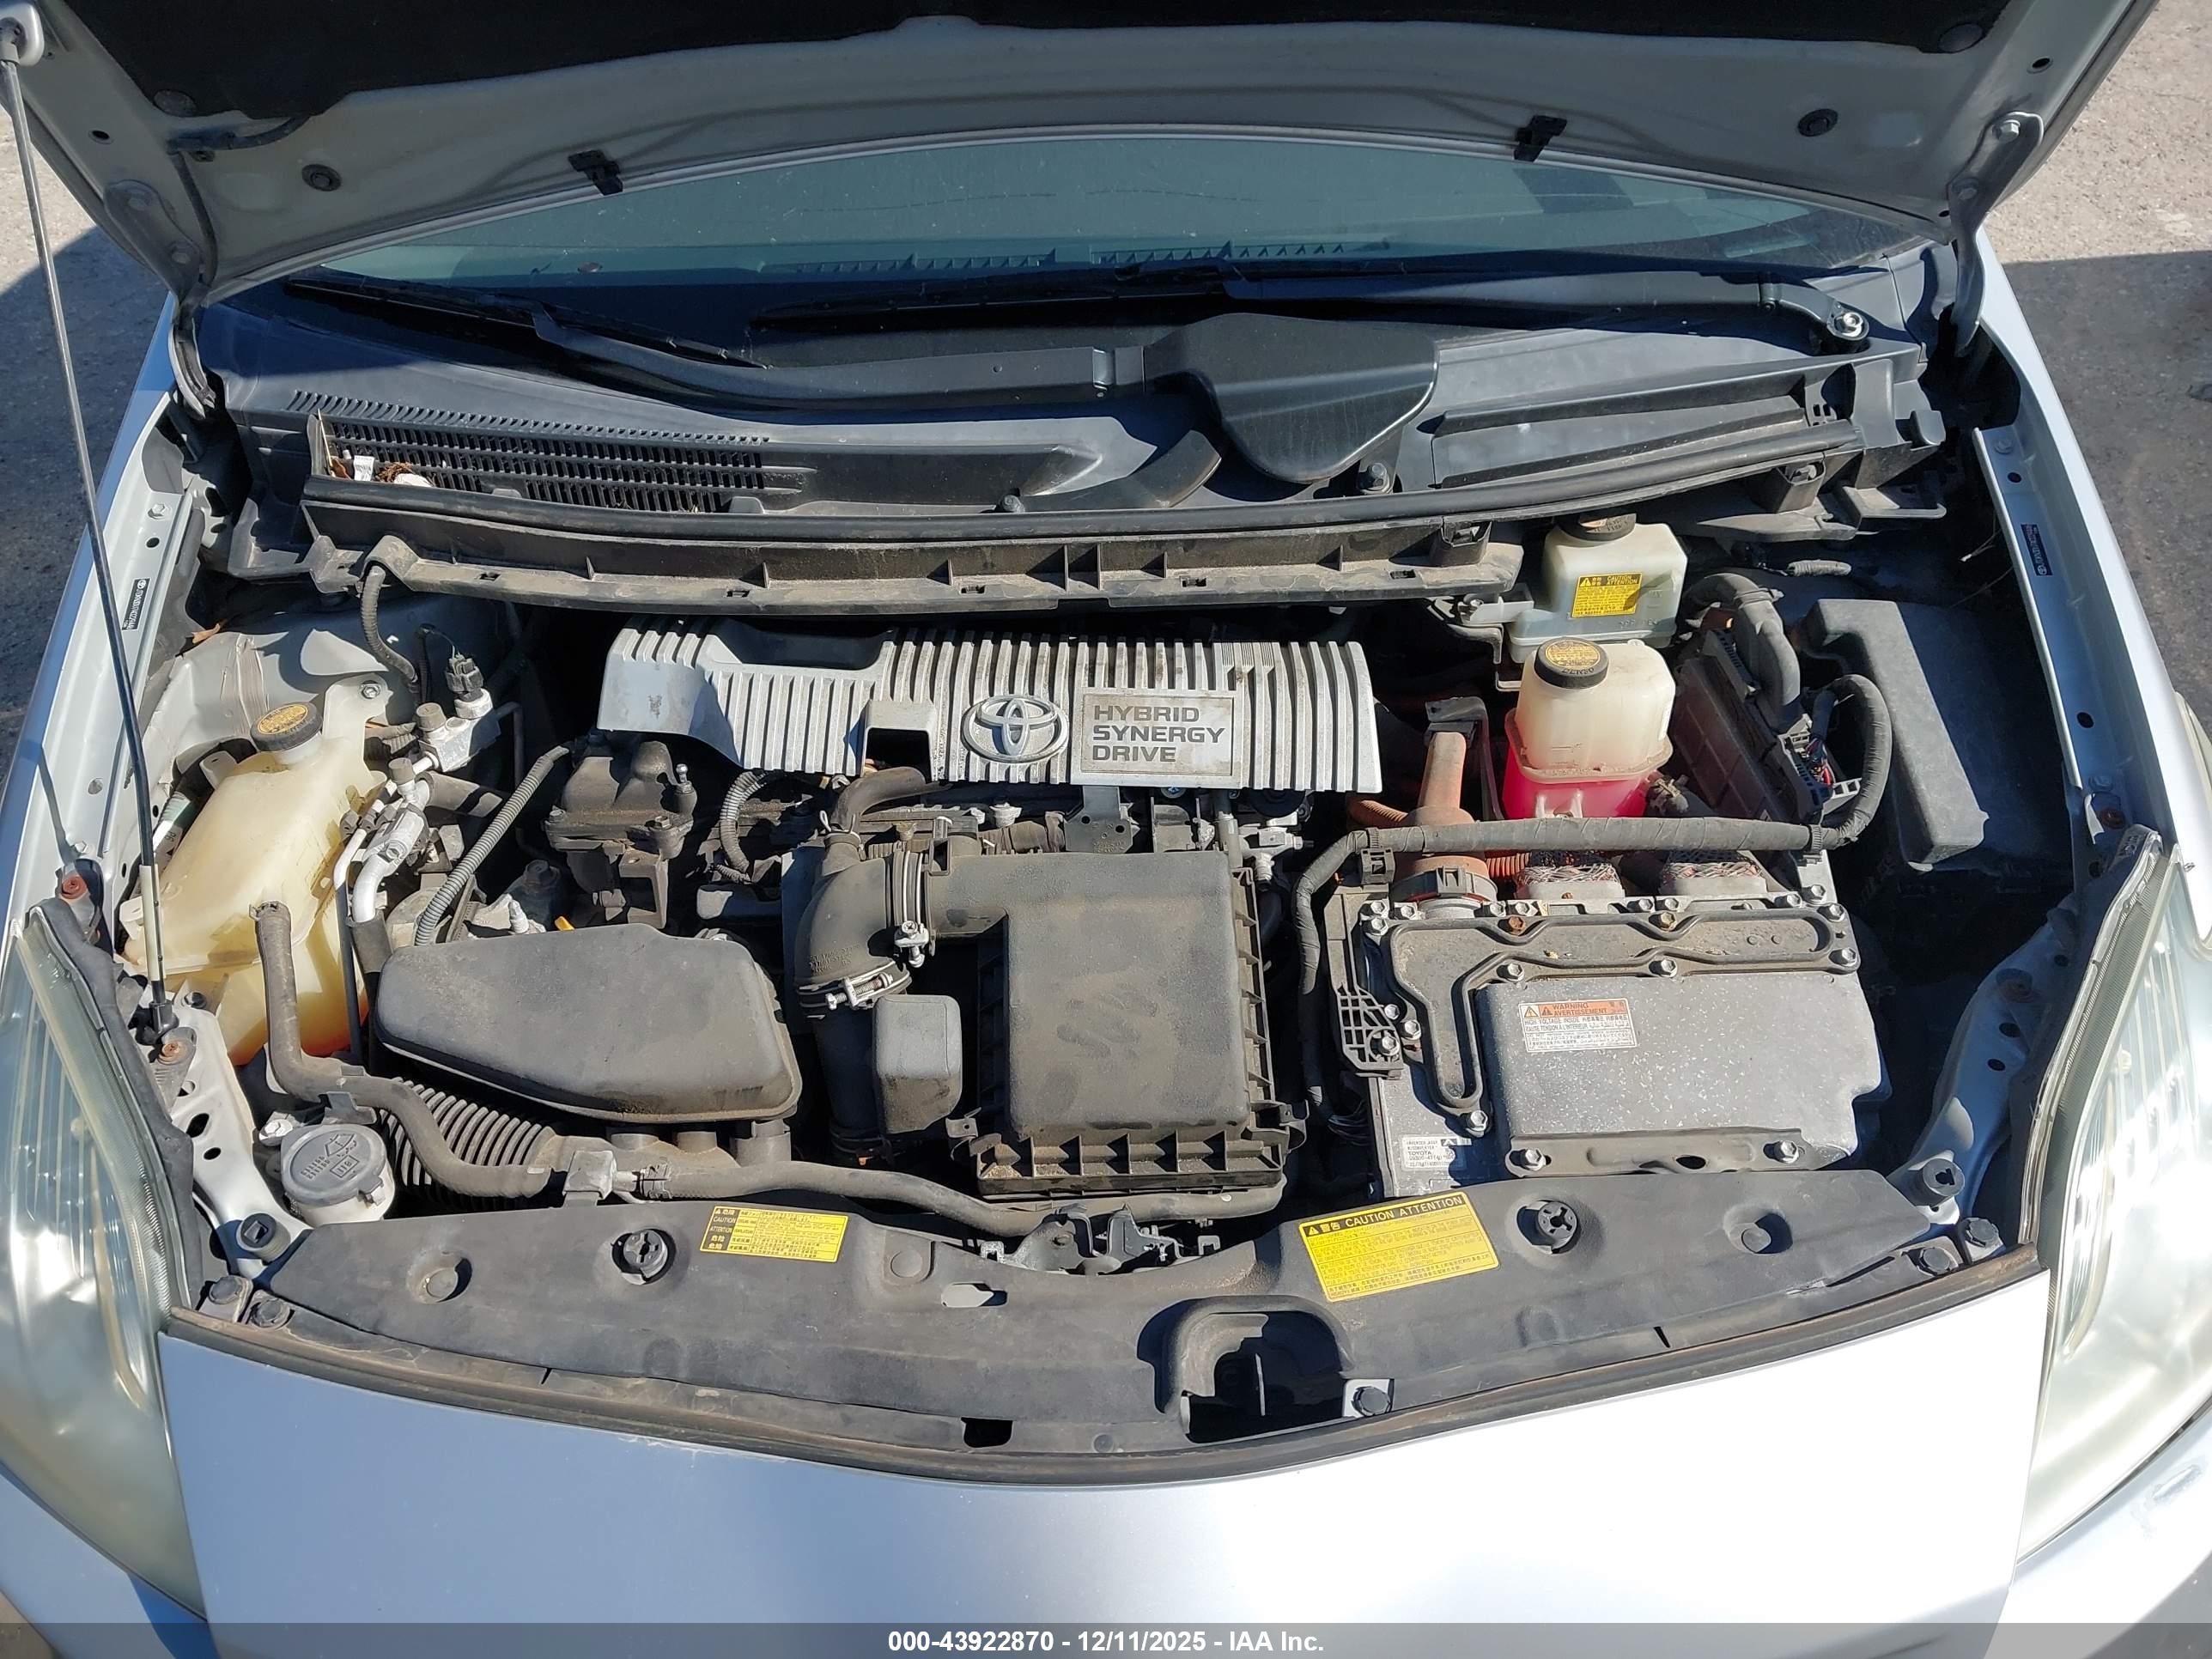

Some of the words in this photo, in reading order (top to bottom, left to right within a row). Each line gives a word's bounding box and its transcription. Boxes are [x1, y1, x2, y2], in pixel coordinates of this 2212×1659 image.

[1094, 705, 1200, 722] HYBRID
[1092, 725, 1225, 743] SYNERGY
[1092, 745, 1176, 763] DRIVE
[1553, 1007, 1607, 1017] AVERTISSEMENT
[1345, 1210, 1395, 1228] CAUTION
[1399, 1196, 1463, 1217] ATTENTION
